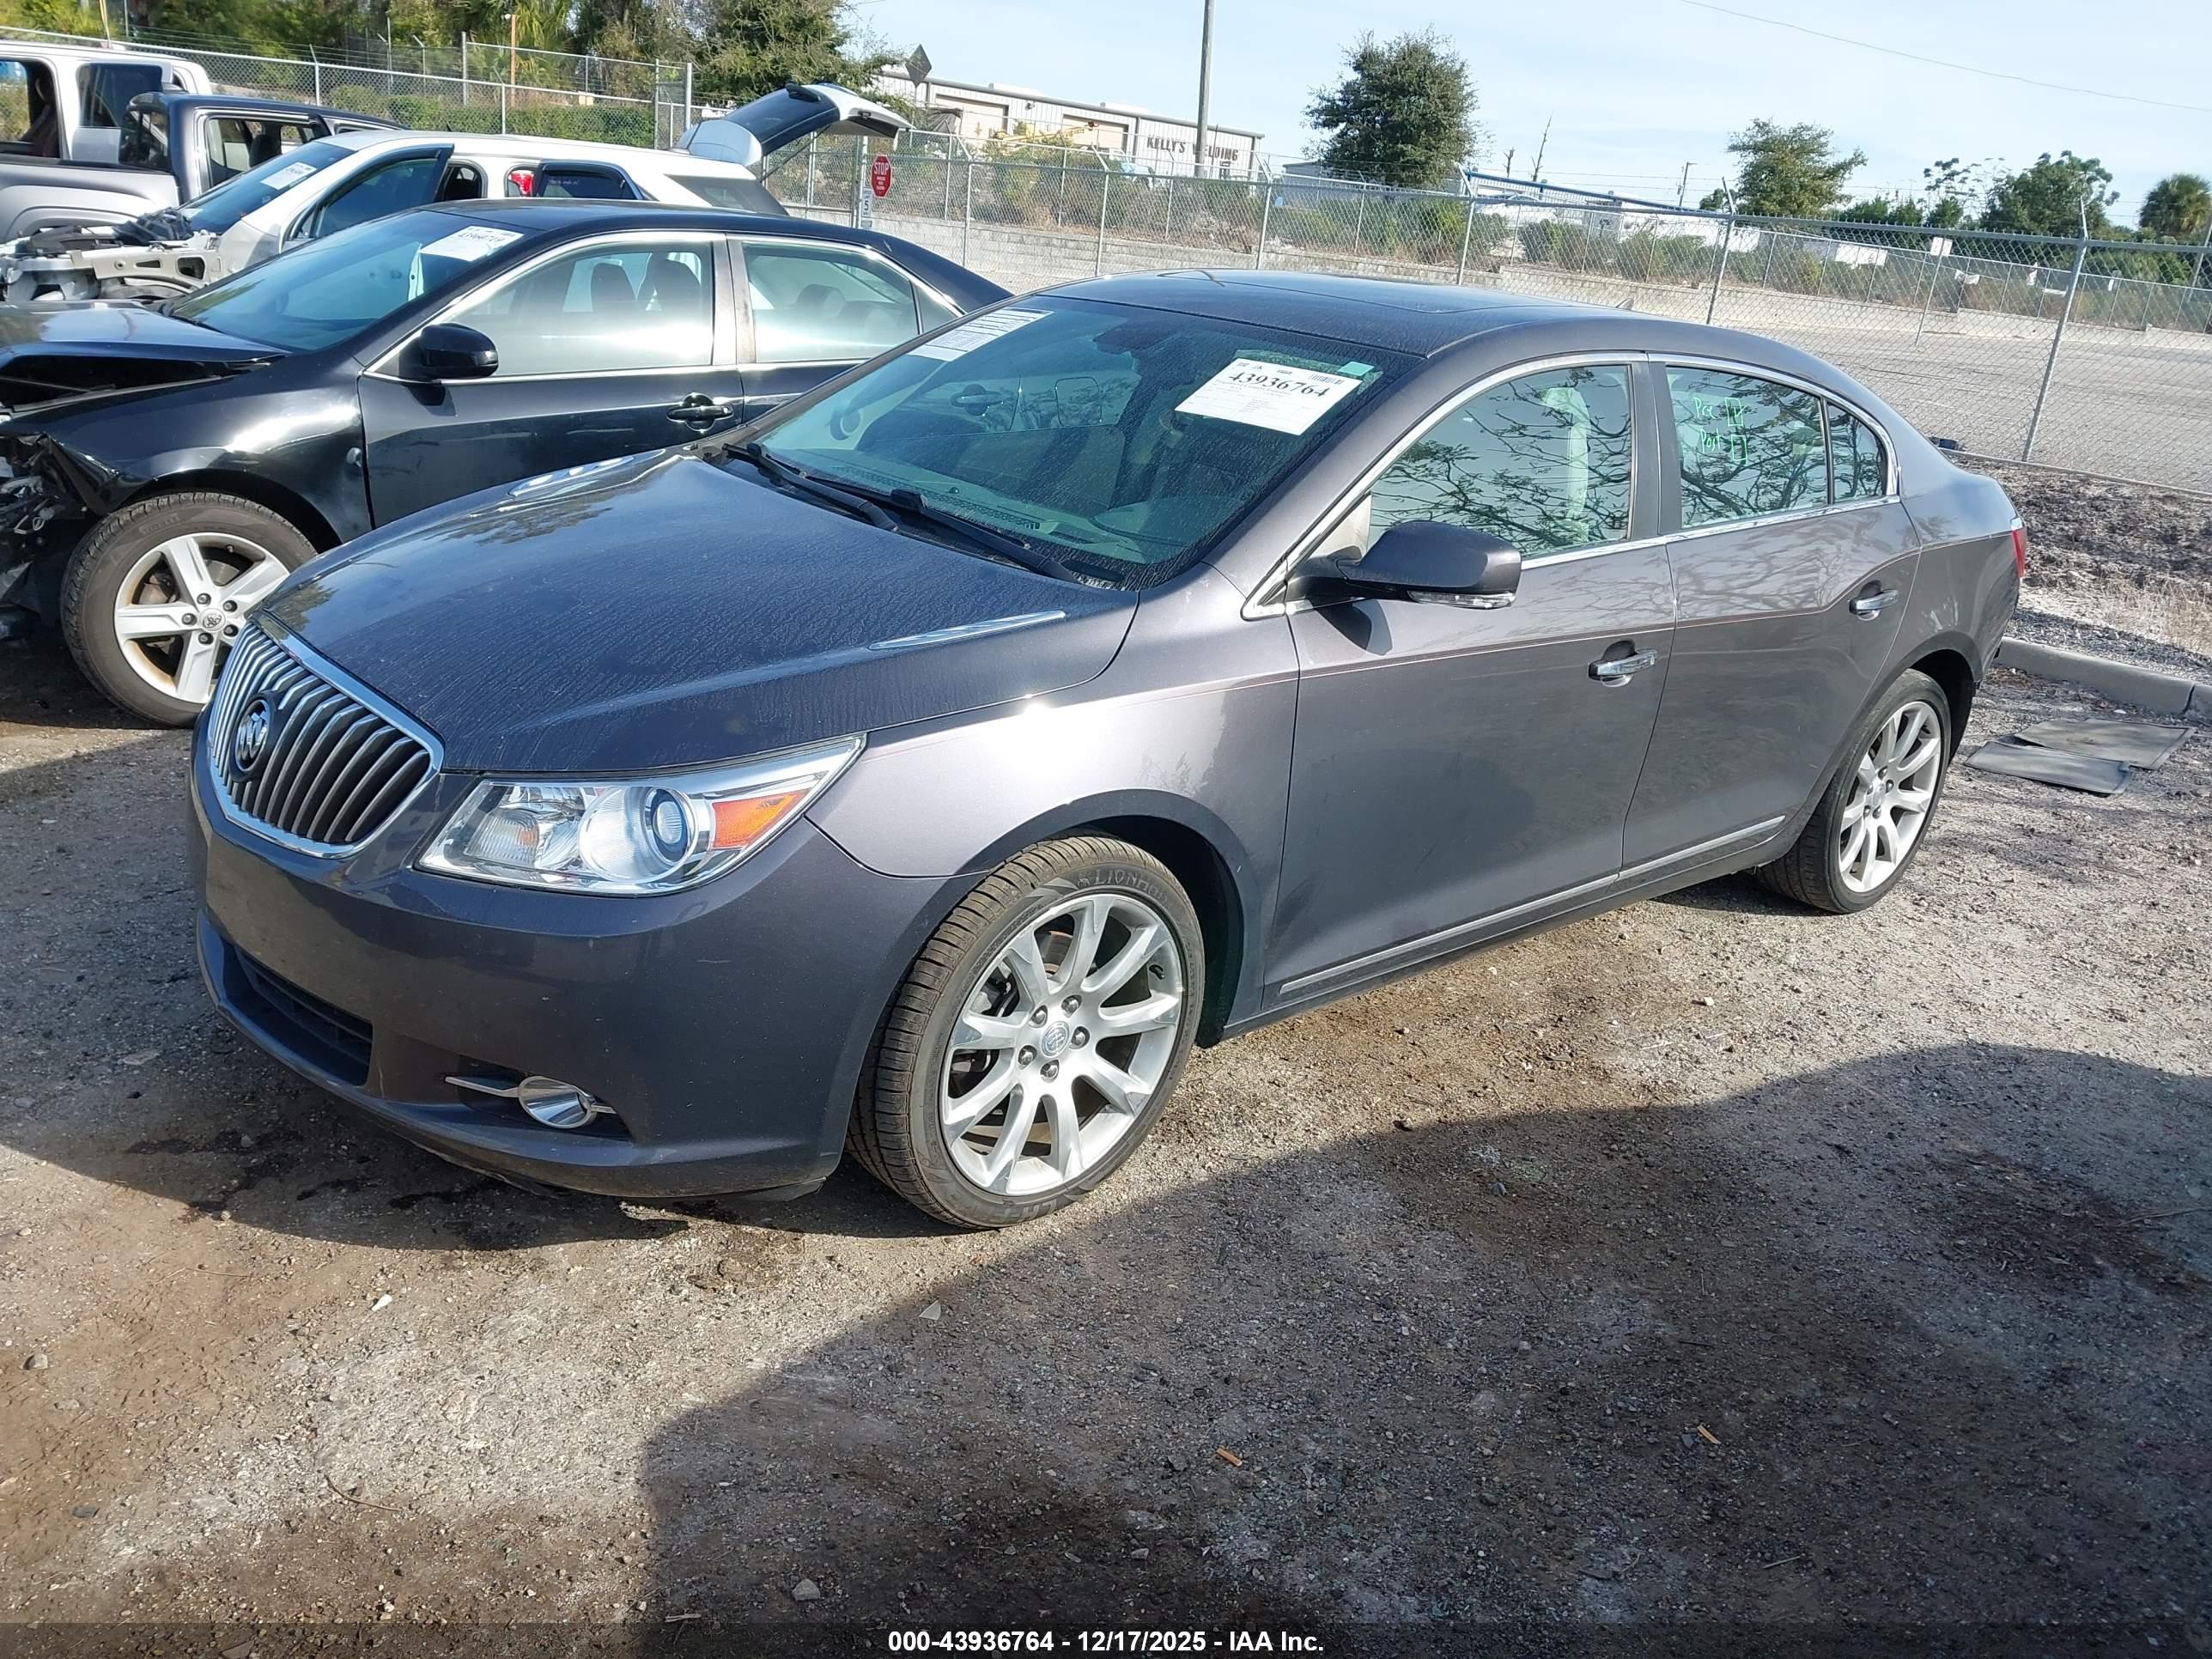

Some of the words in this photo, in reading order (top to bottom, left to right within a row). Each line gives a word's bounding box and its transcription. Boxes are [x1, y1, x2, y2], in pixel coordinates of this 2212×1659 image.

[1147, 137, 1186, 153] KELLY'S
[873, 161, 890, 175] STOP
[1229, 371, 1331, 398] 43936764
[1700, 428, 1722, 454] Post
